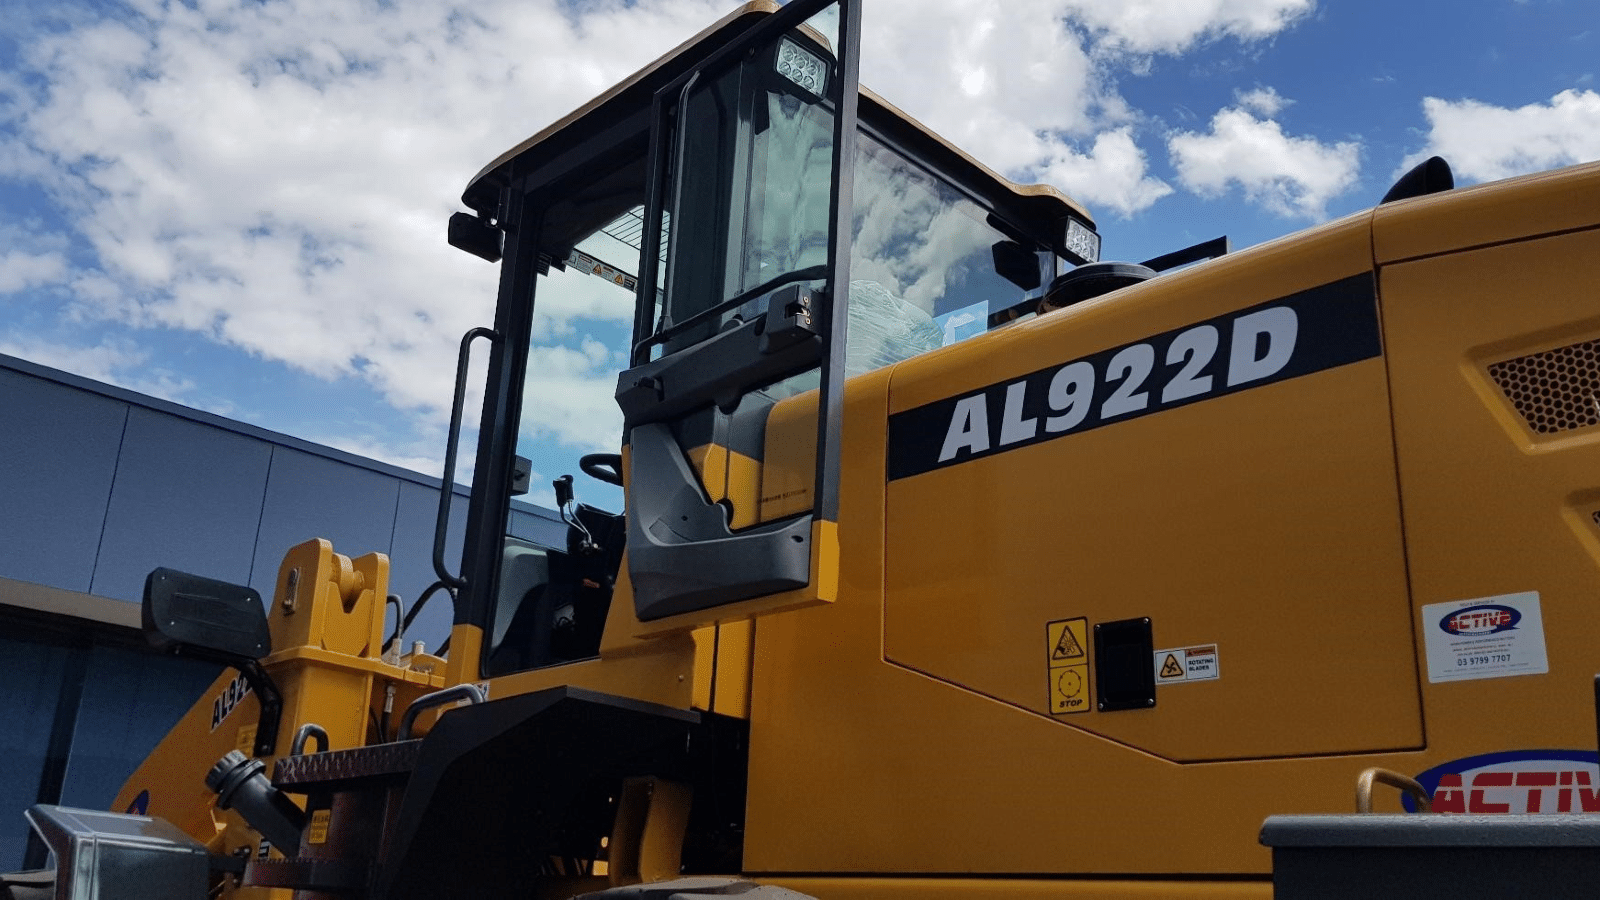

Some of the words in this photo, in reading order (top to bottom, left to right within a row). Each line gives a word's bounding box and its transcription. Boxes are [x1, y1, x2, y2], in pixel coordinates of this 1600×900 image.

[937, 306, 1299, 463] AL922D
[1448, 610, 1511, 631] ACTIVE
[1188, 657, 1214, 666] ROTATING
[1457, 658, 1467, 666] 03
[1470, 656, 1489, 665] 9799
[1491, 654, 1511, 662] 7707
[211, 675, 252, 729] AL92
[1058, 699, 1083, 708] STOP
